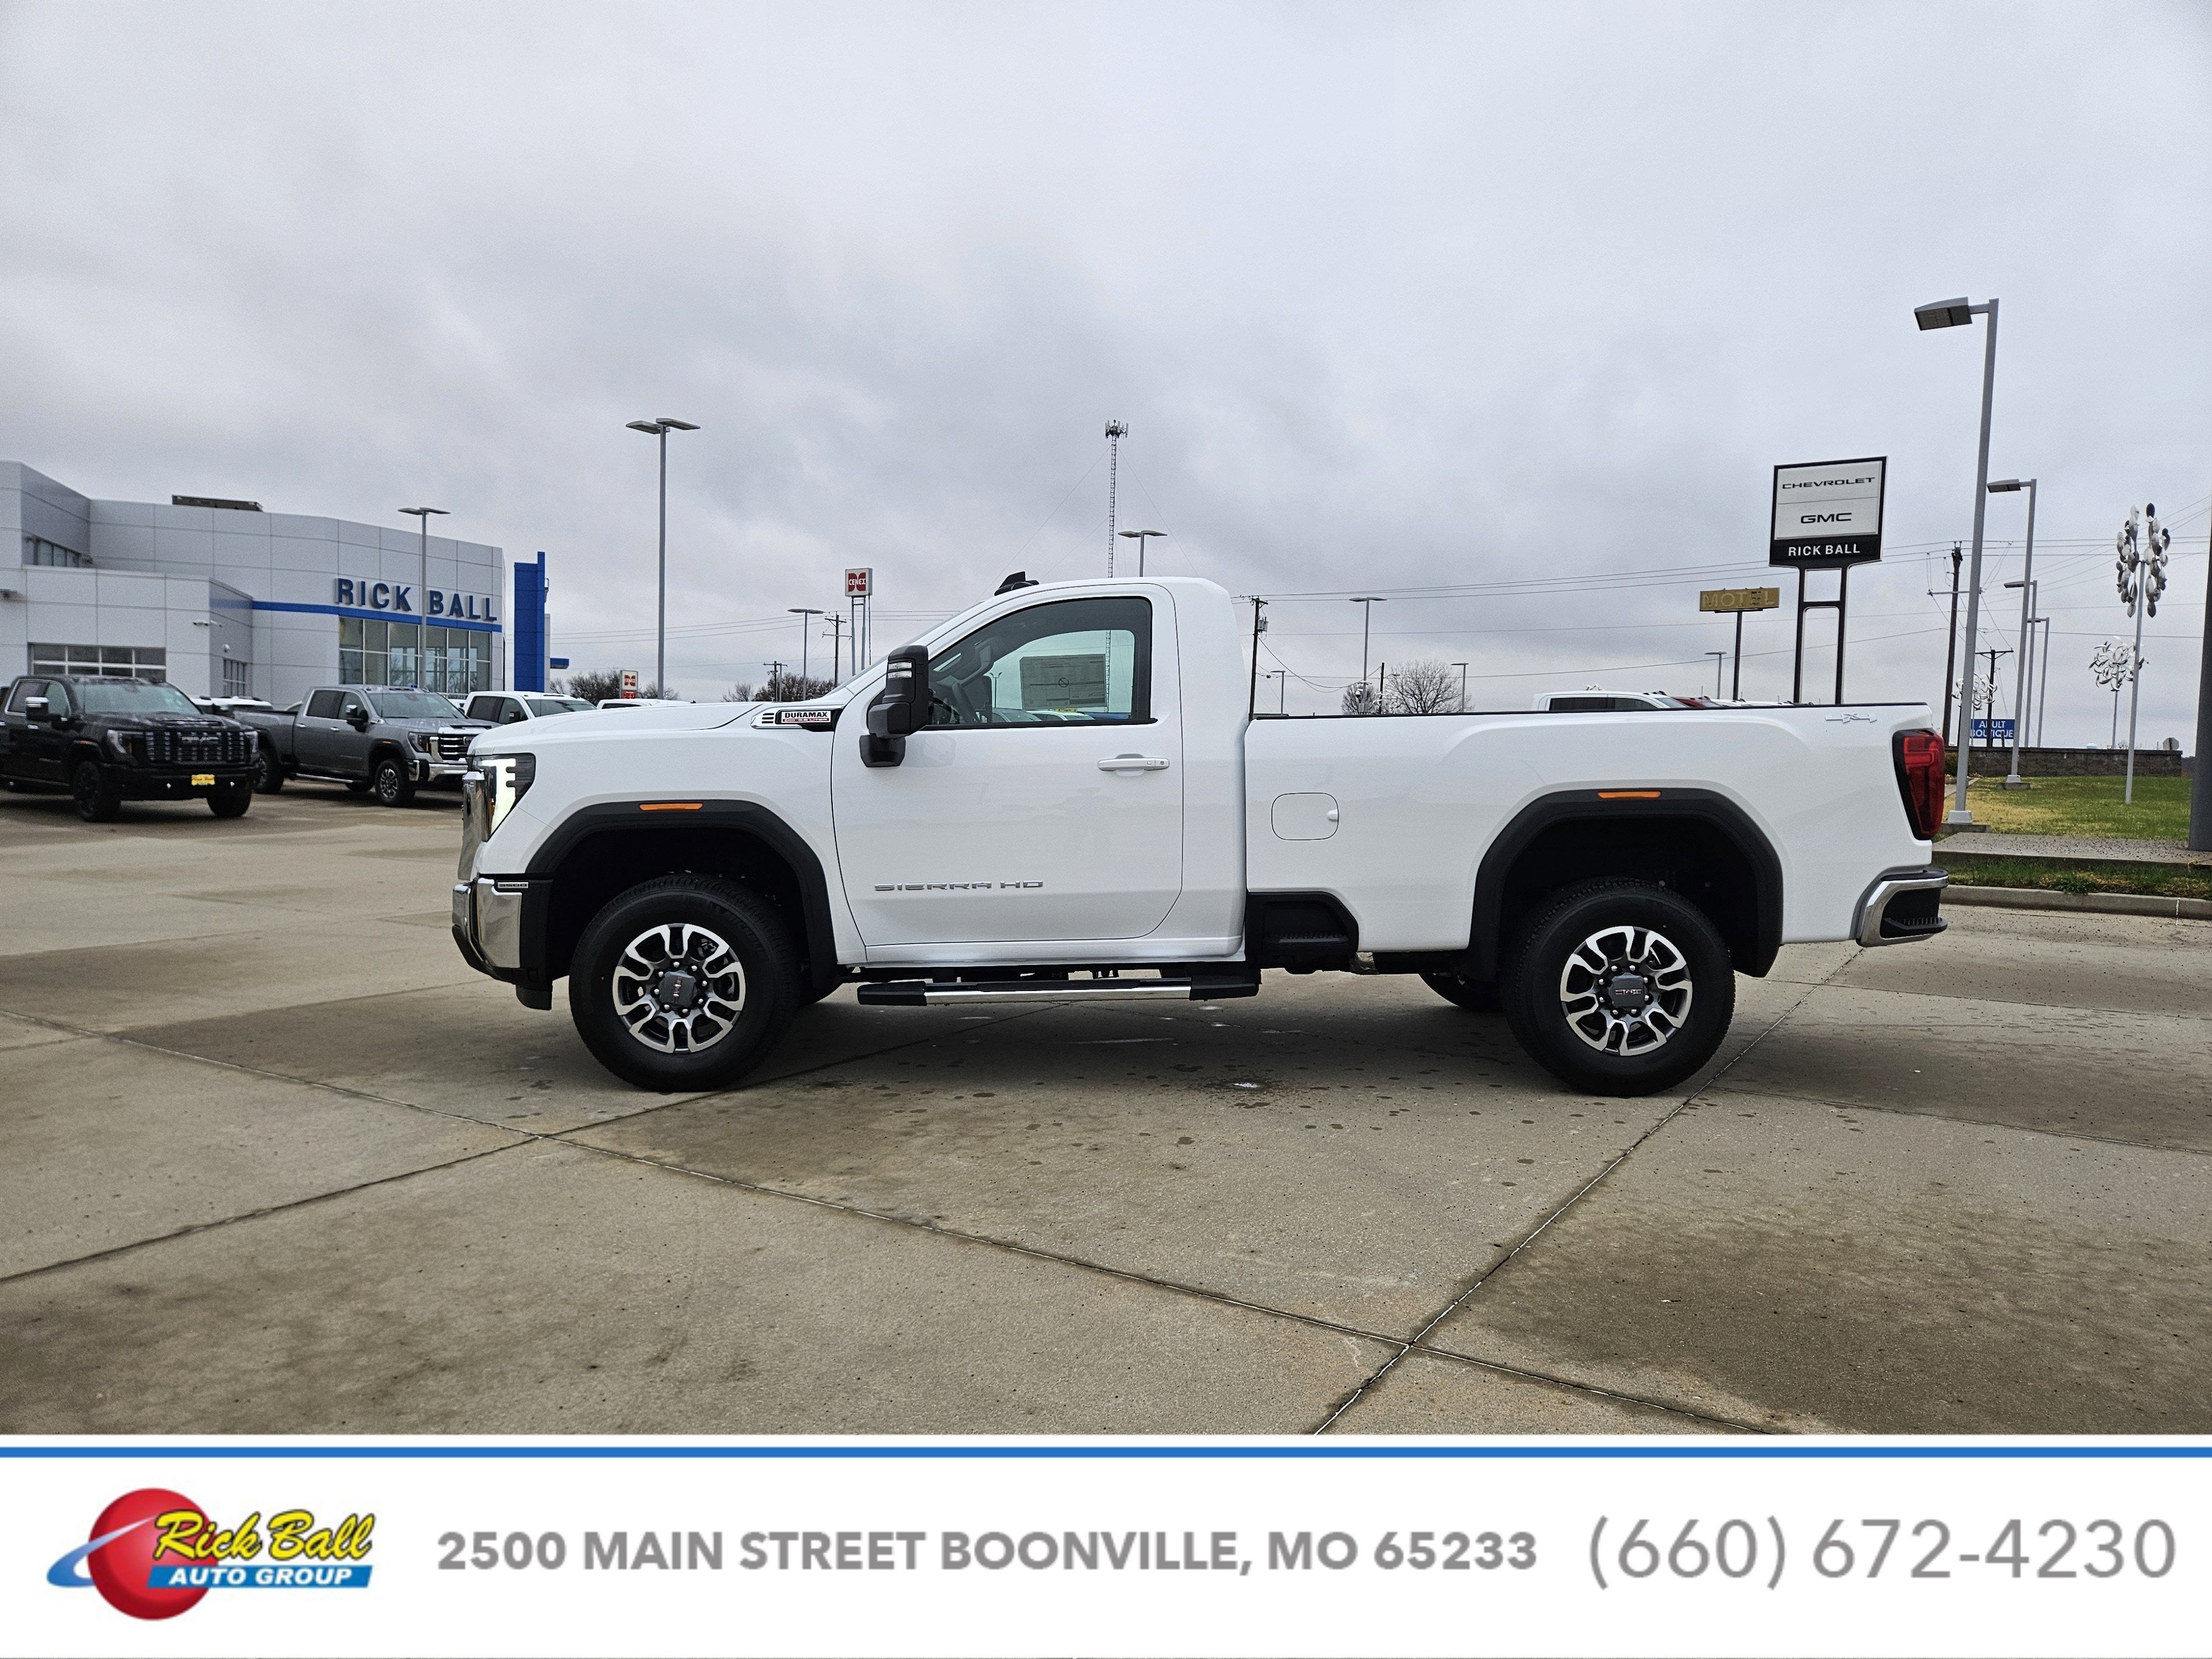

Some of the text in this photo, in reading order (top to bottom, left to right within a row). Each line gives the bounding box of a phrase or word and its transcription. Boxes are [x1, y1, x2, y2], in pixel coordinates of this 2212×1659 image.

[1782, 477, 1876, 489] CHEVROLET
[1800, 512, 1852, 524] GMC
[1788, 543, 1860, 557] RICK BALL
[336, 577, 497, 622] RICK BALL
[1702, 590, 1776, 608] MOTEL
[1979, 720, 2006, 728] AULT
[874, 879, 1044, 891] SIERRA HD
